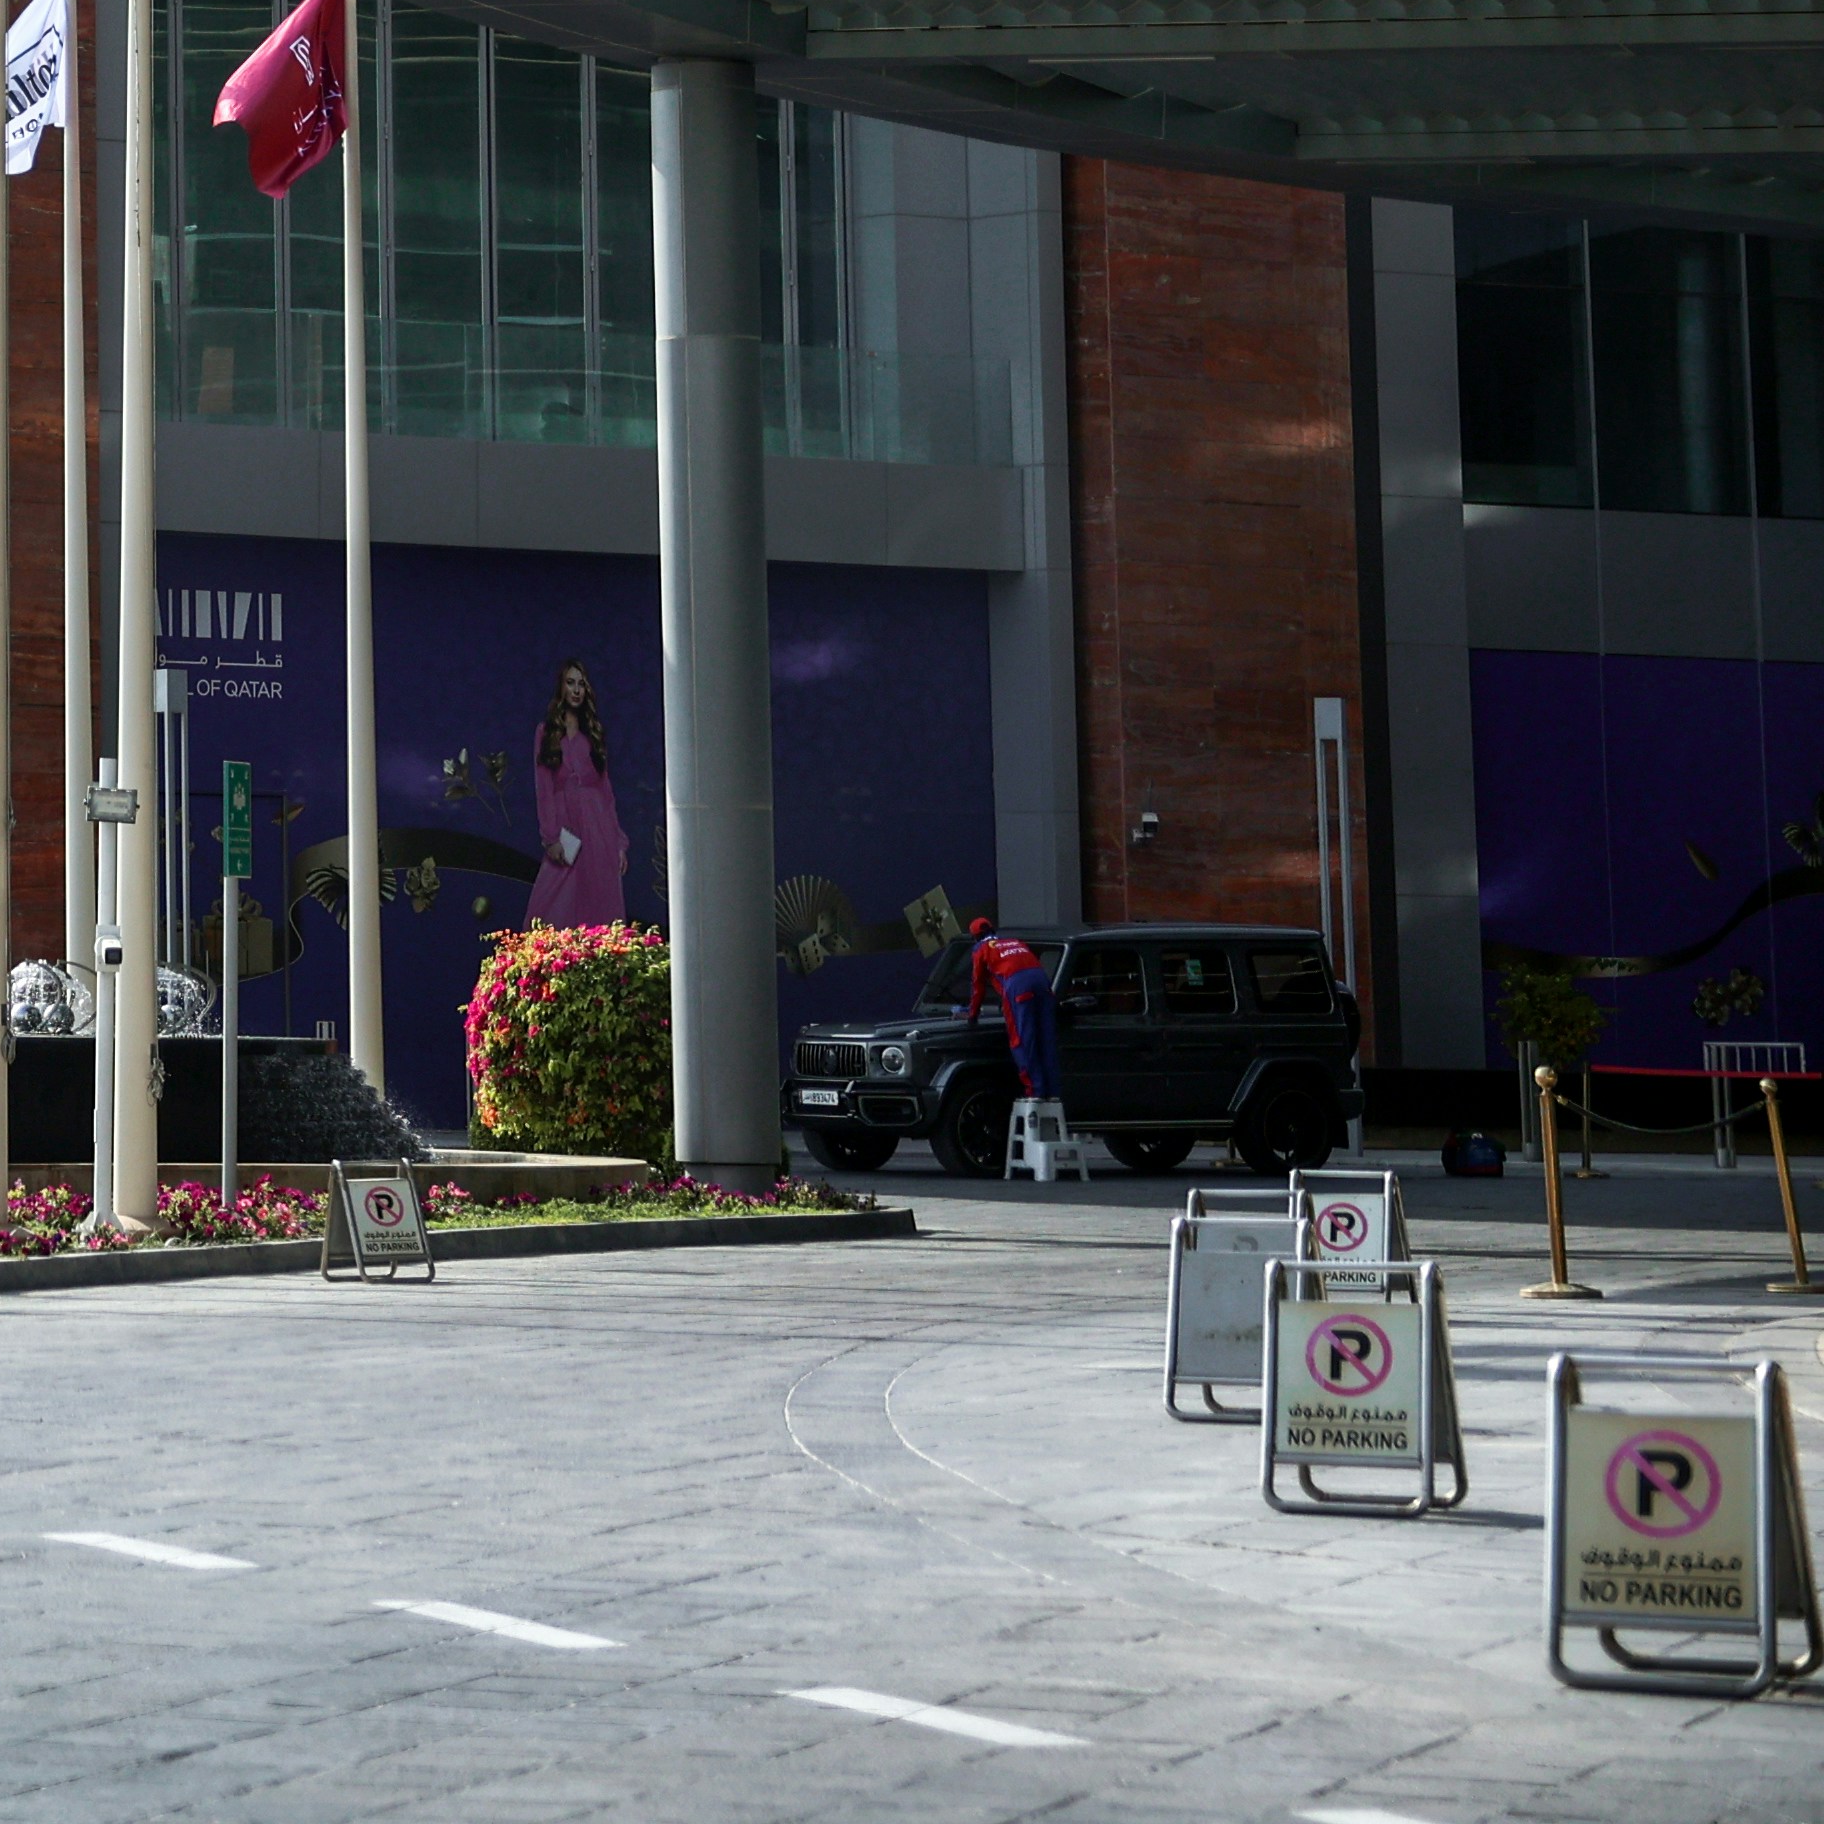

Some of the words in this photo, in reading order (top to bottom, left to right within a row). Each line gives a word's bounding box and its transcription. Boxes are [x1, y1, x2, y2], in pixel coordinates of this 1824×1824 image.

[158, 654, 208, 666] مو
[215, 651, 283, 669] قطر
[197, 679, 221, 696] OF
[224, 680, 283, 699] QATAR
[365, 1243, 379, 1252] NO
[381, 1242, 420, 1252] PARKING
[1324, 1271, 1376, 1283] PARKING
[1288, 1402, 1347, 1422] الوقوف
[1351, 1404, 1408, 1423] ممنوع
[1287, 1427, 1316, 1446] NO
[1321, 1428, 1408, 1451] PARKING
[1581, 1546, 1660, 1572] الوقوف
[1664, 1551, 1743, 1573] ممنوع
[1580, 1579, 1619, 1604] NO
[1625, 1580, 1743, 1609] PARKING
